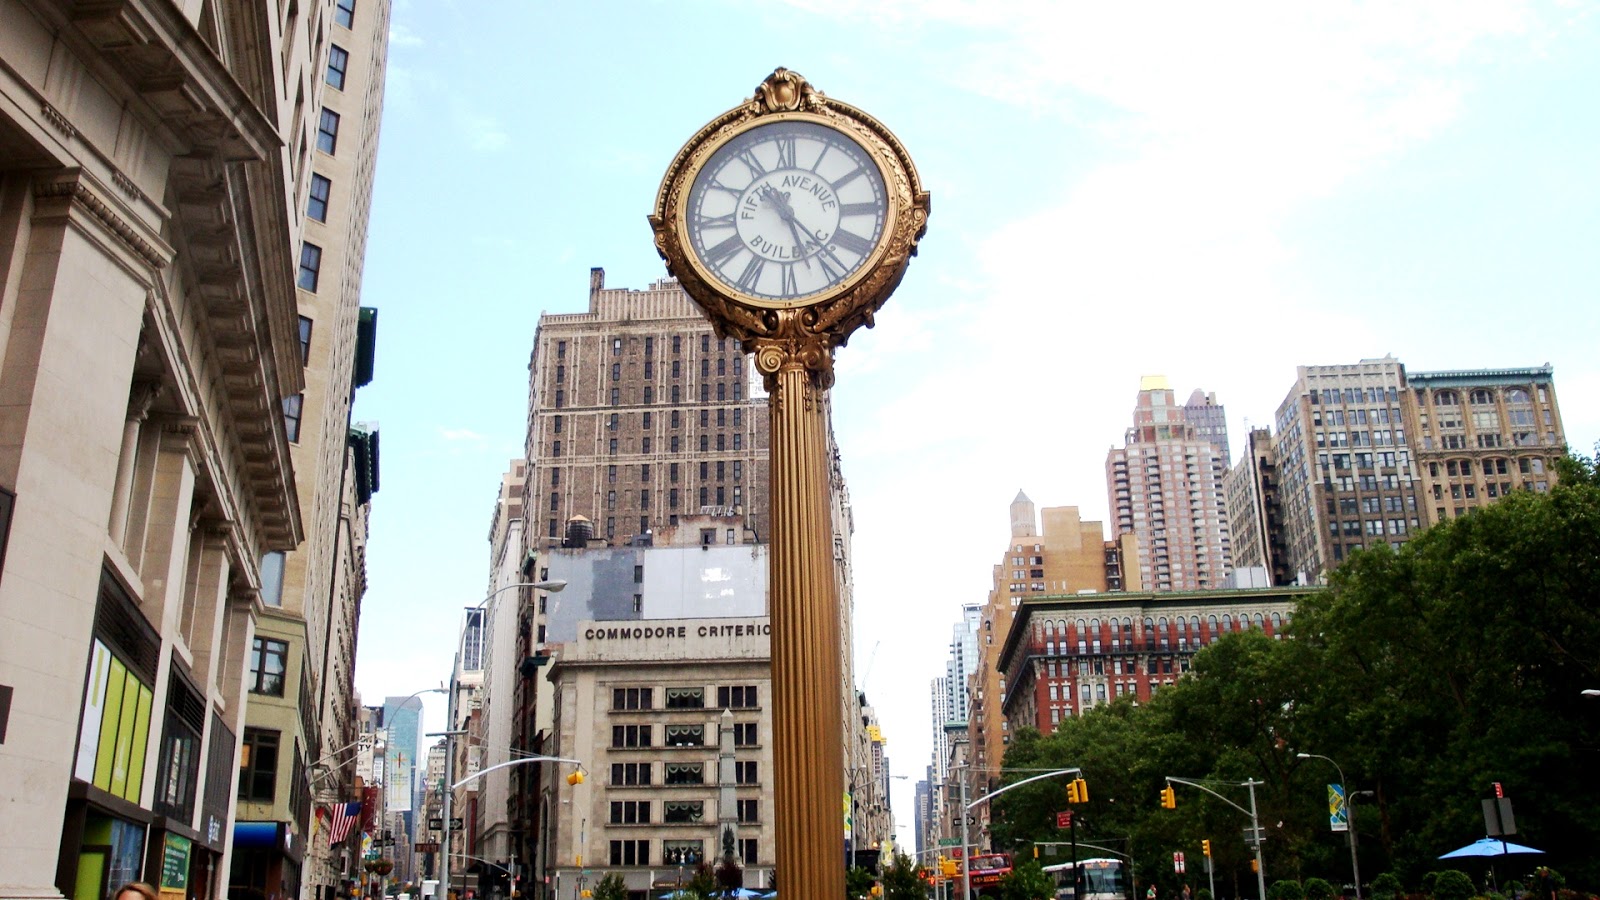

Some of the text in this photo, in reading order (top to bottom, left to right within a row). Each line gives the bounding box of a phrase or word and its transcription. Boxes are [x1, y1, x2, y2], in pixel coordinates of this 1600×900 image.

[775, 139, 796, 169] XII
[741, 175, 836, 220] FIFTH AVENUE
[750, 229, 829, 259] BUILDNG
[585, 624, 770, 641] COMMODORE CRITERIO
